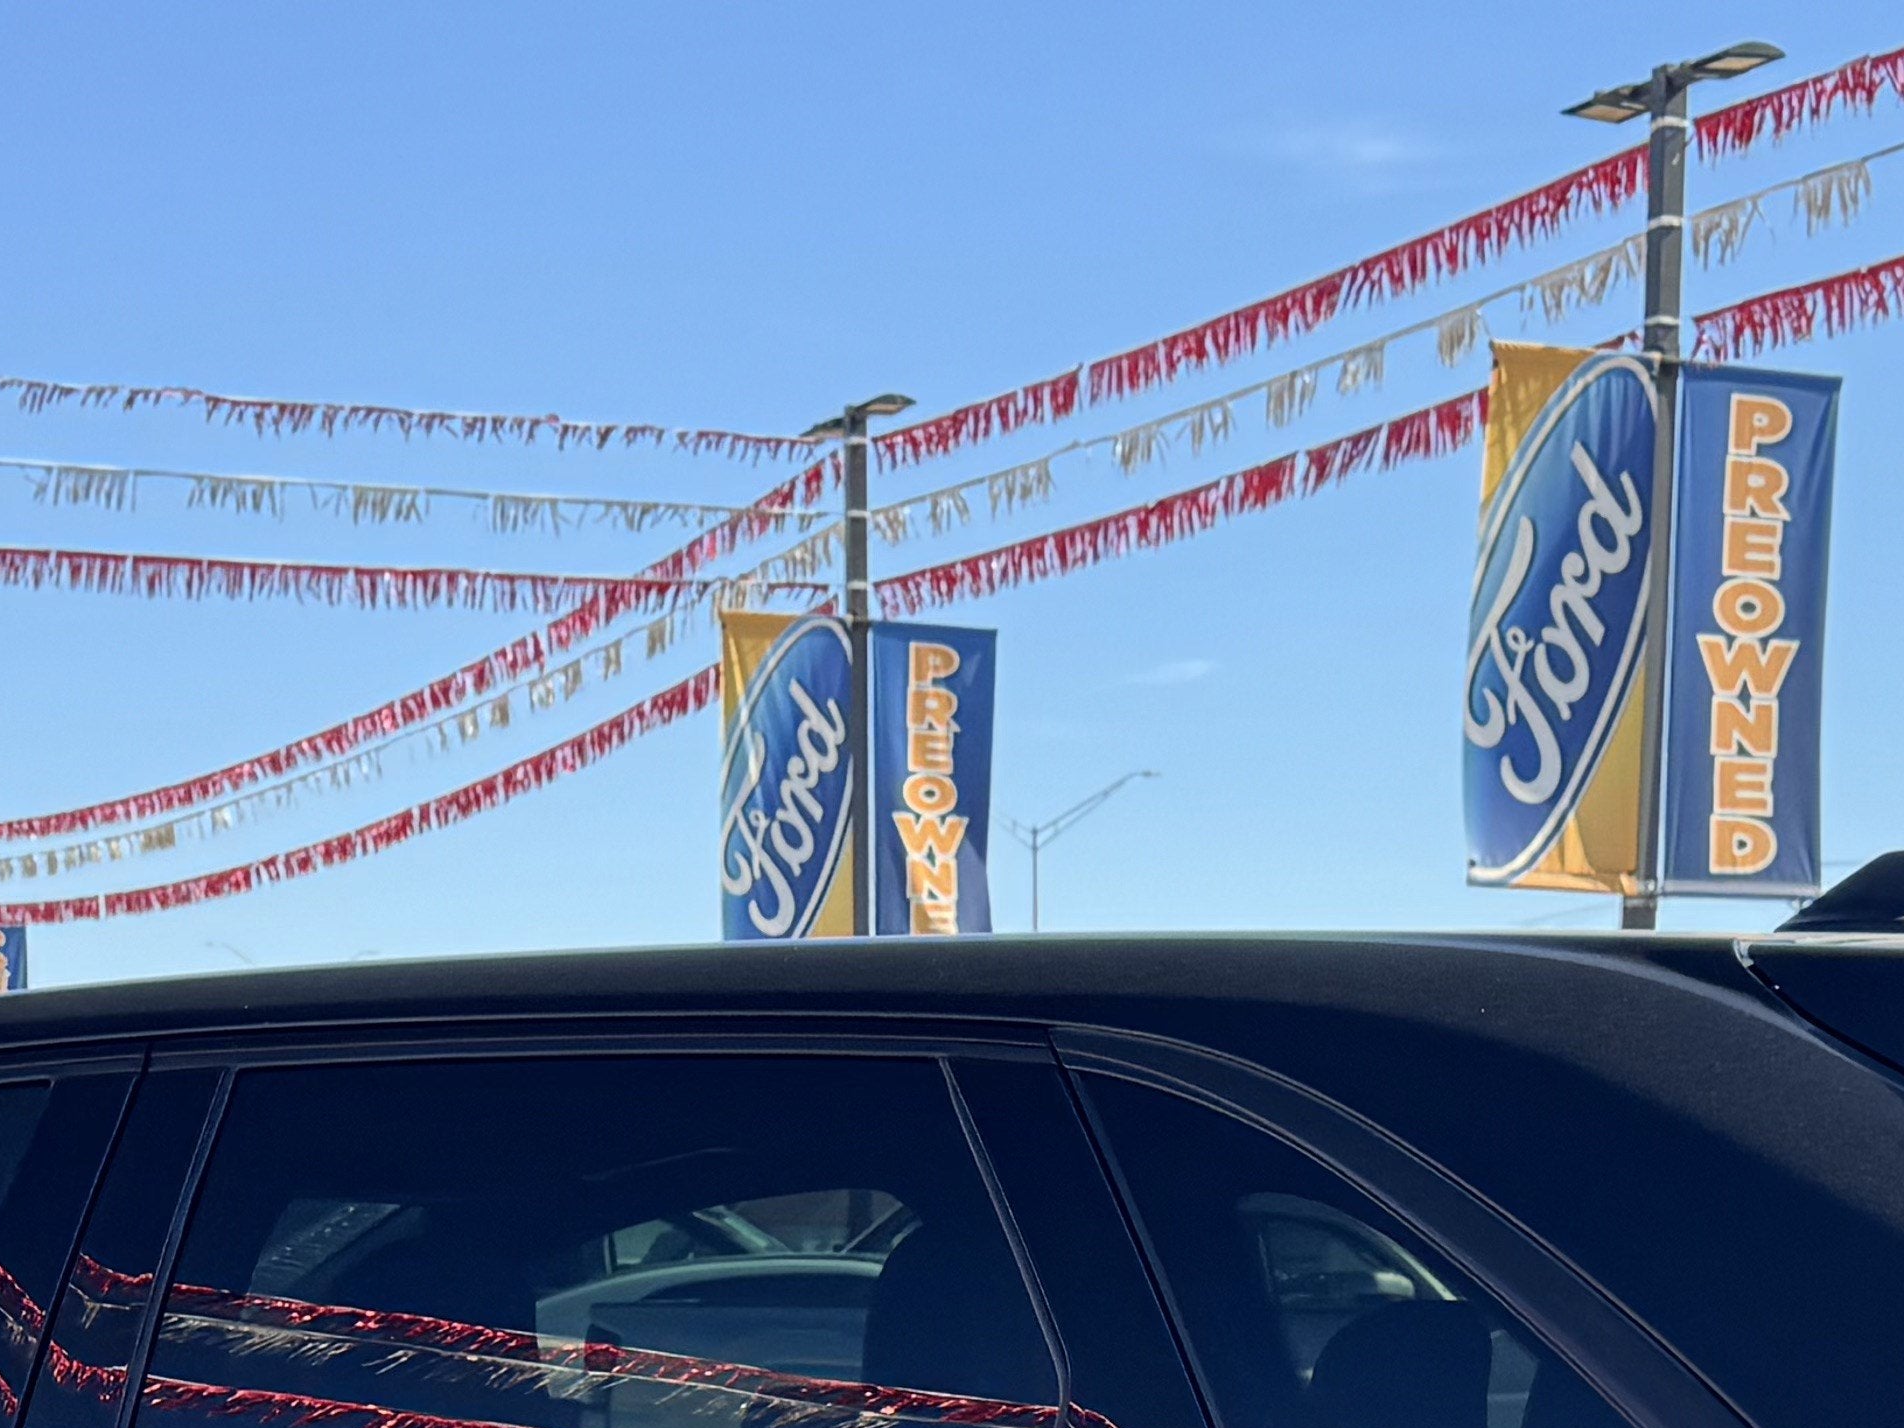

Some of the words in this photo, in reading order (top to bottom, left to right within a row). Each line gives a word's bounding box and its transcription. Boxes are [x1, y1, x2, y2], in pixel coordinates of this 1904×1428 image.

[1463, 440, 1644, 804] Ford
[1696, 392, 1800, 875] PREOWNED
[721, 678, 846, 937] Ford
